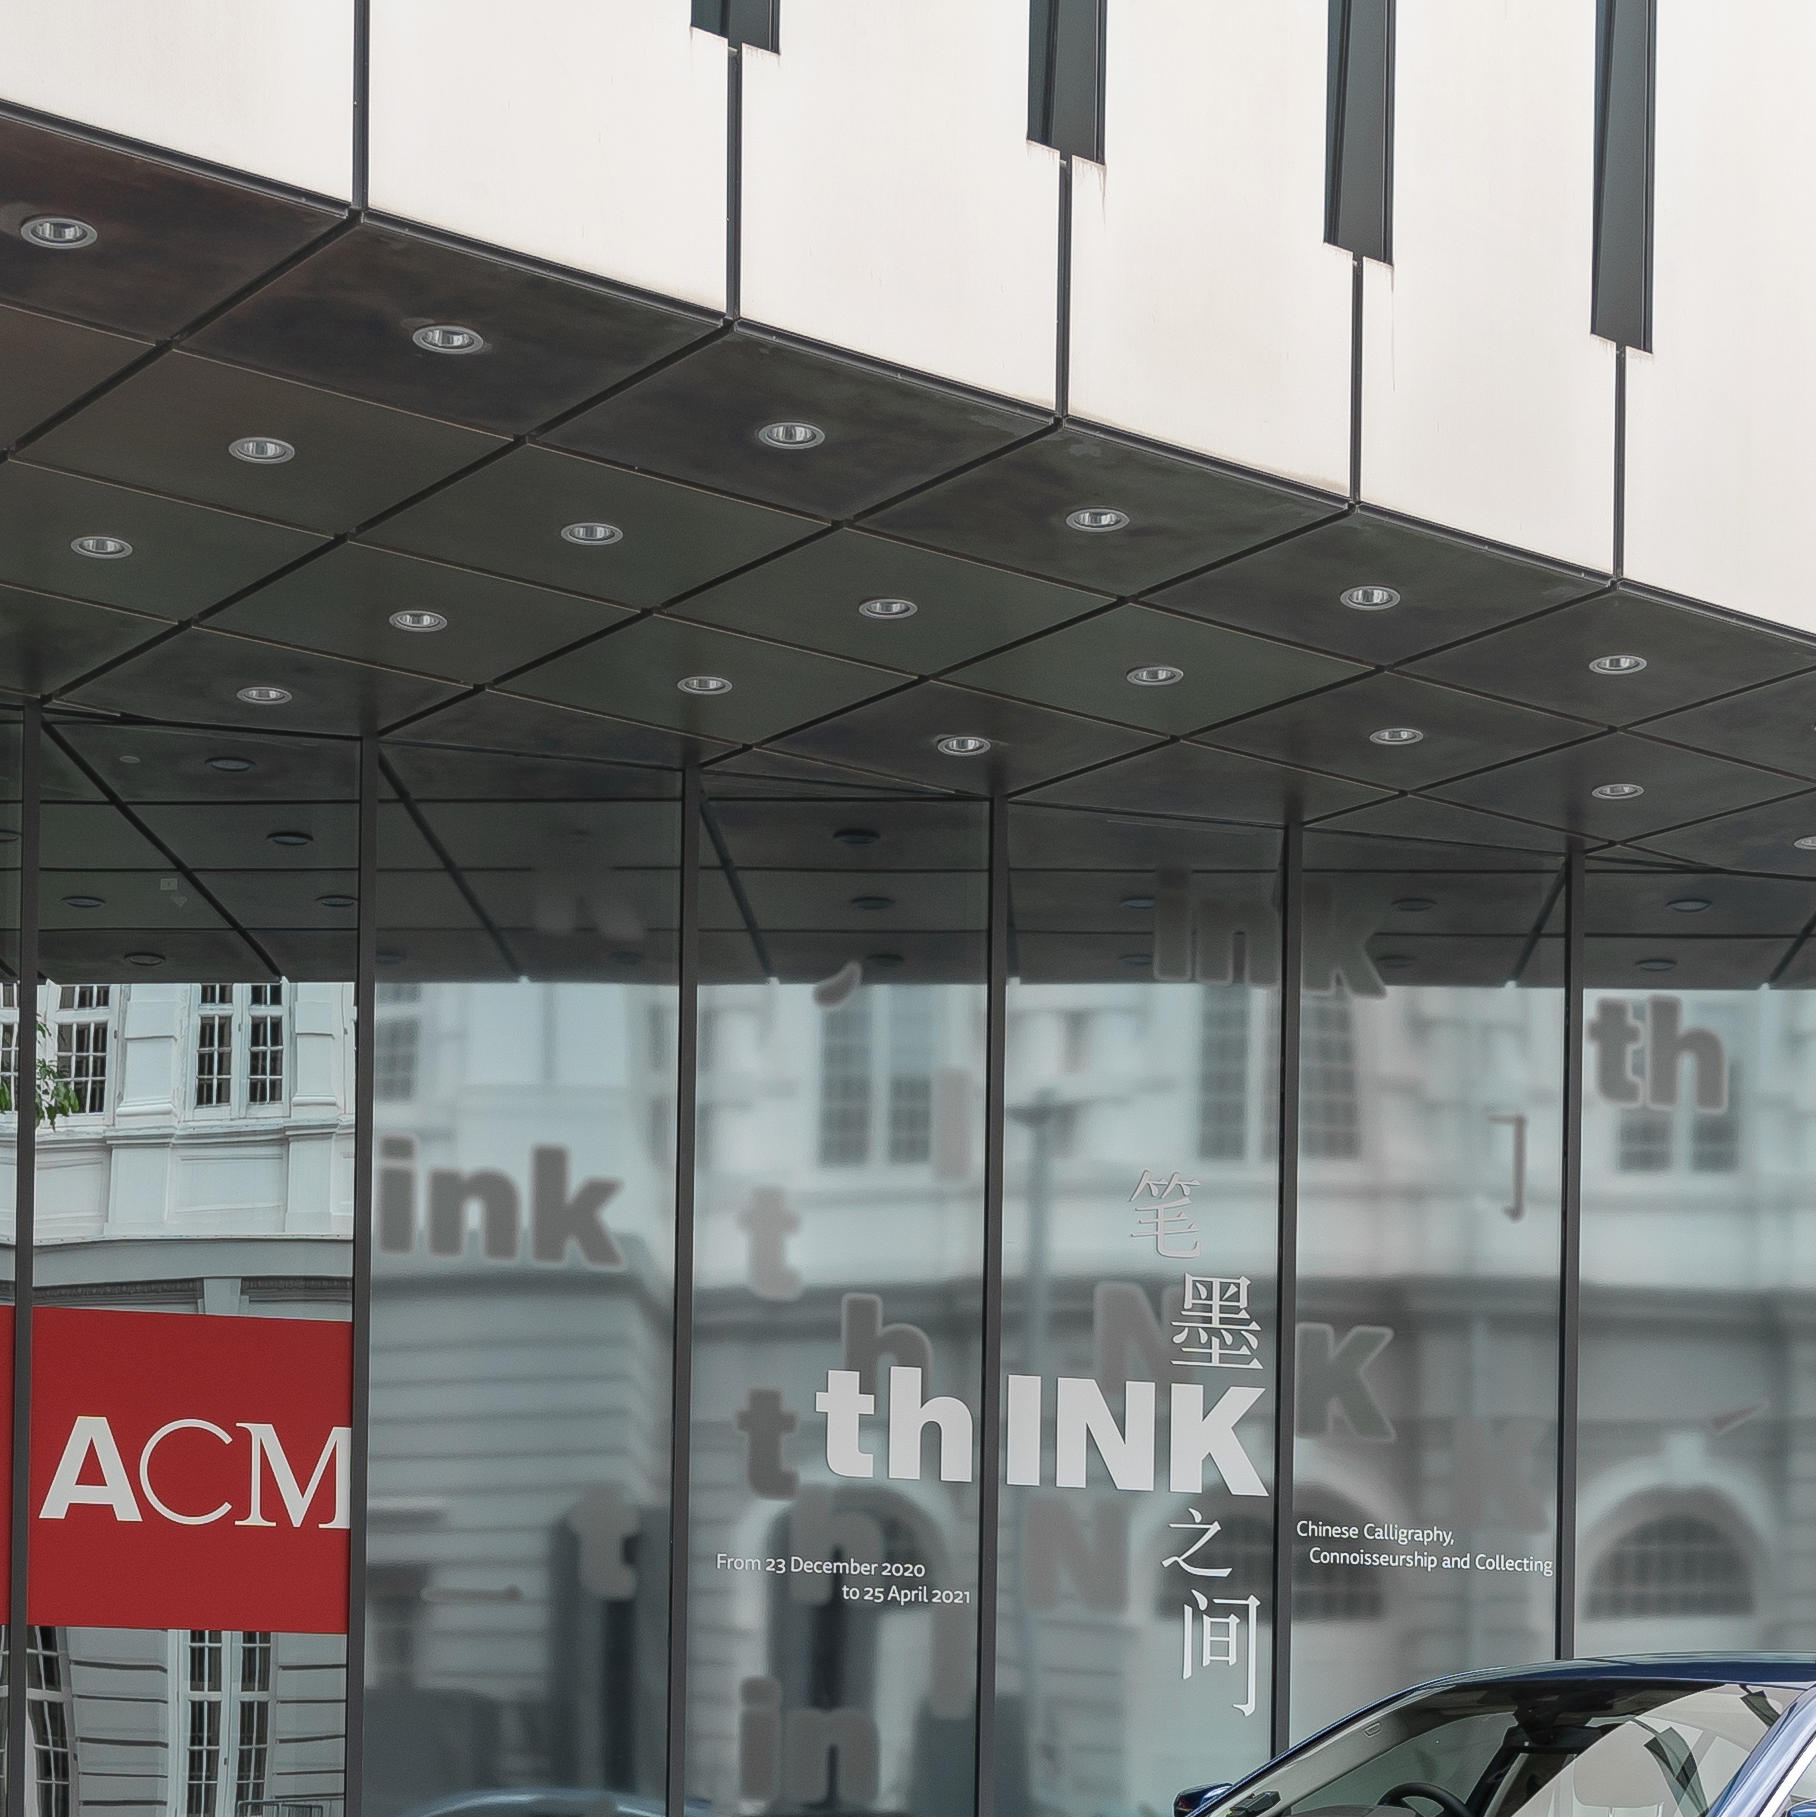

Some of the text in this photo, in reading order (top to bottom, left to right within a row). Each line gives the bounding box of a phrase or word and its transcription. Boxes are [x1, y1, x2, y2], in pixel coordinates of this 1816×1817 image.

[376, 1135, 626, 1269] ink
[38, 1416, 351, 1529] ACM
[1296, 1520, 1455, 1546] Chinese Calligraphy,
[716, 1553, 926, 1578] From 23 December 2020
[1309, 1547, 1554, 1577] Connoisseurship and Collecting
[842, 1584, 971, 1606] to 25 April 2021
